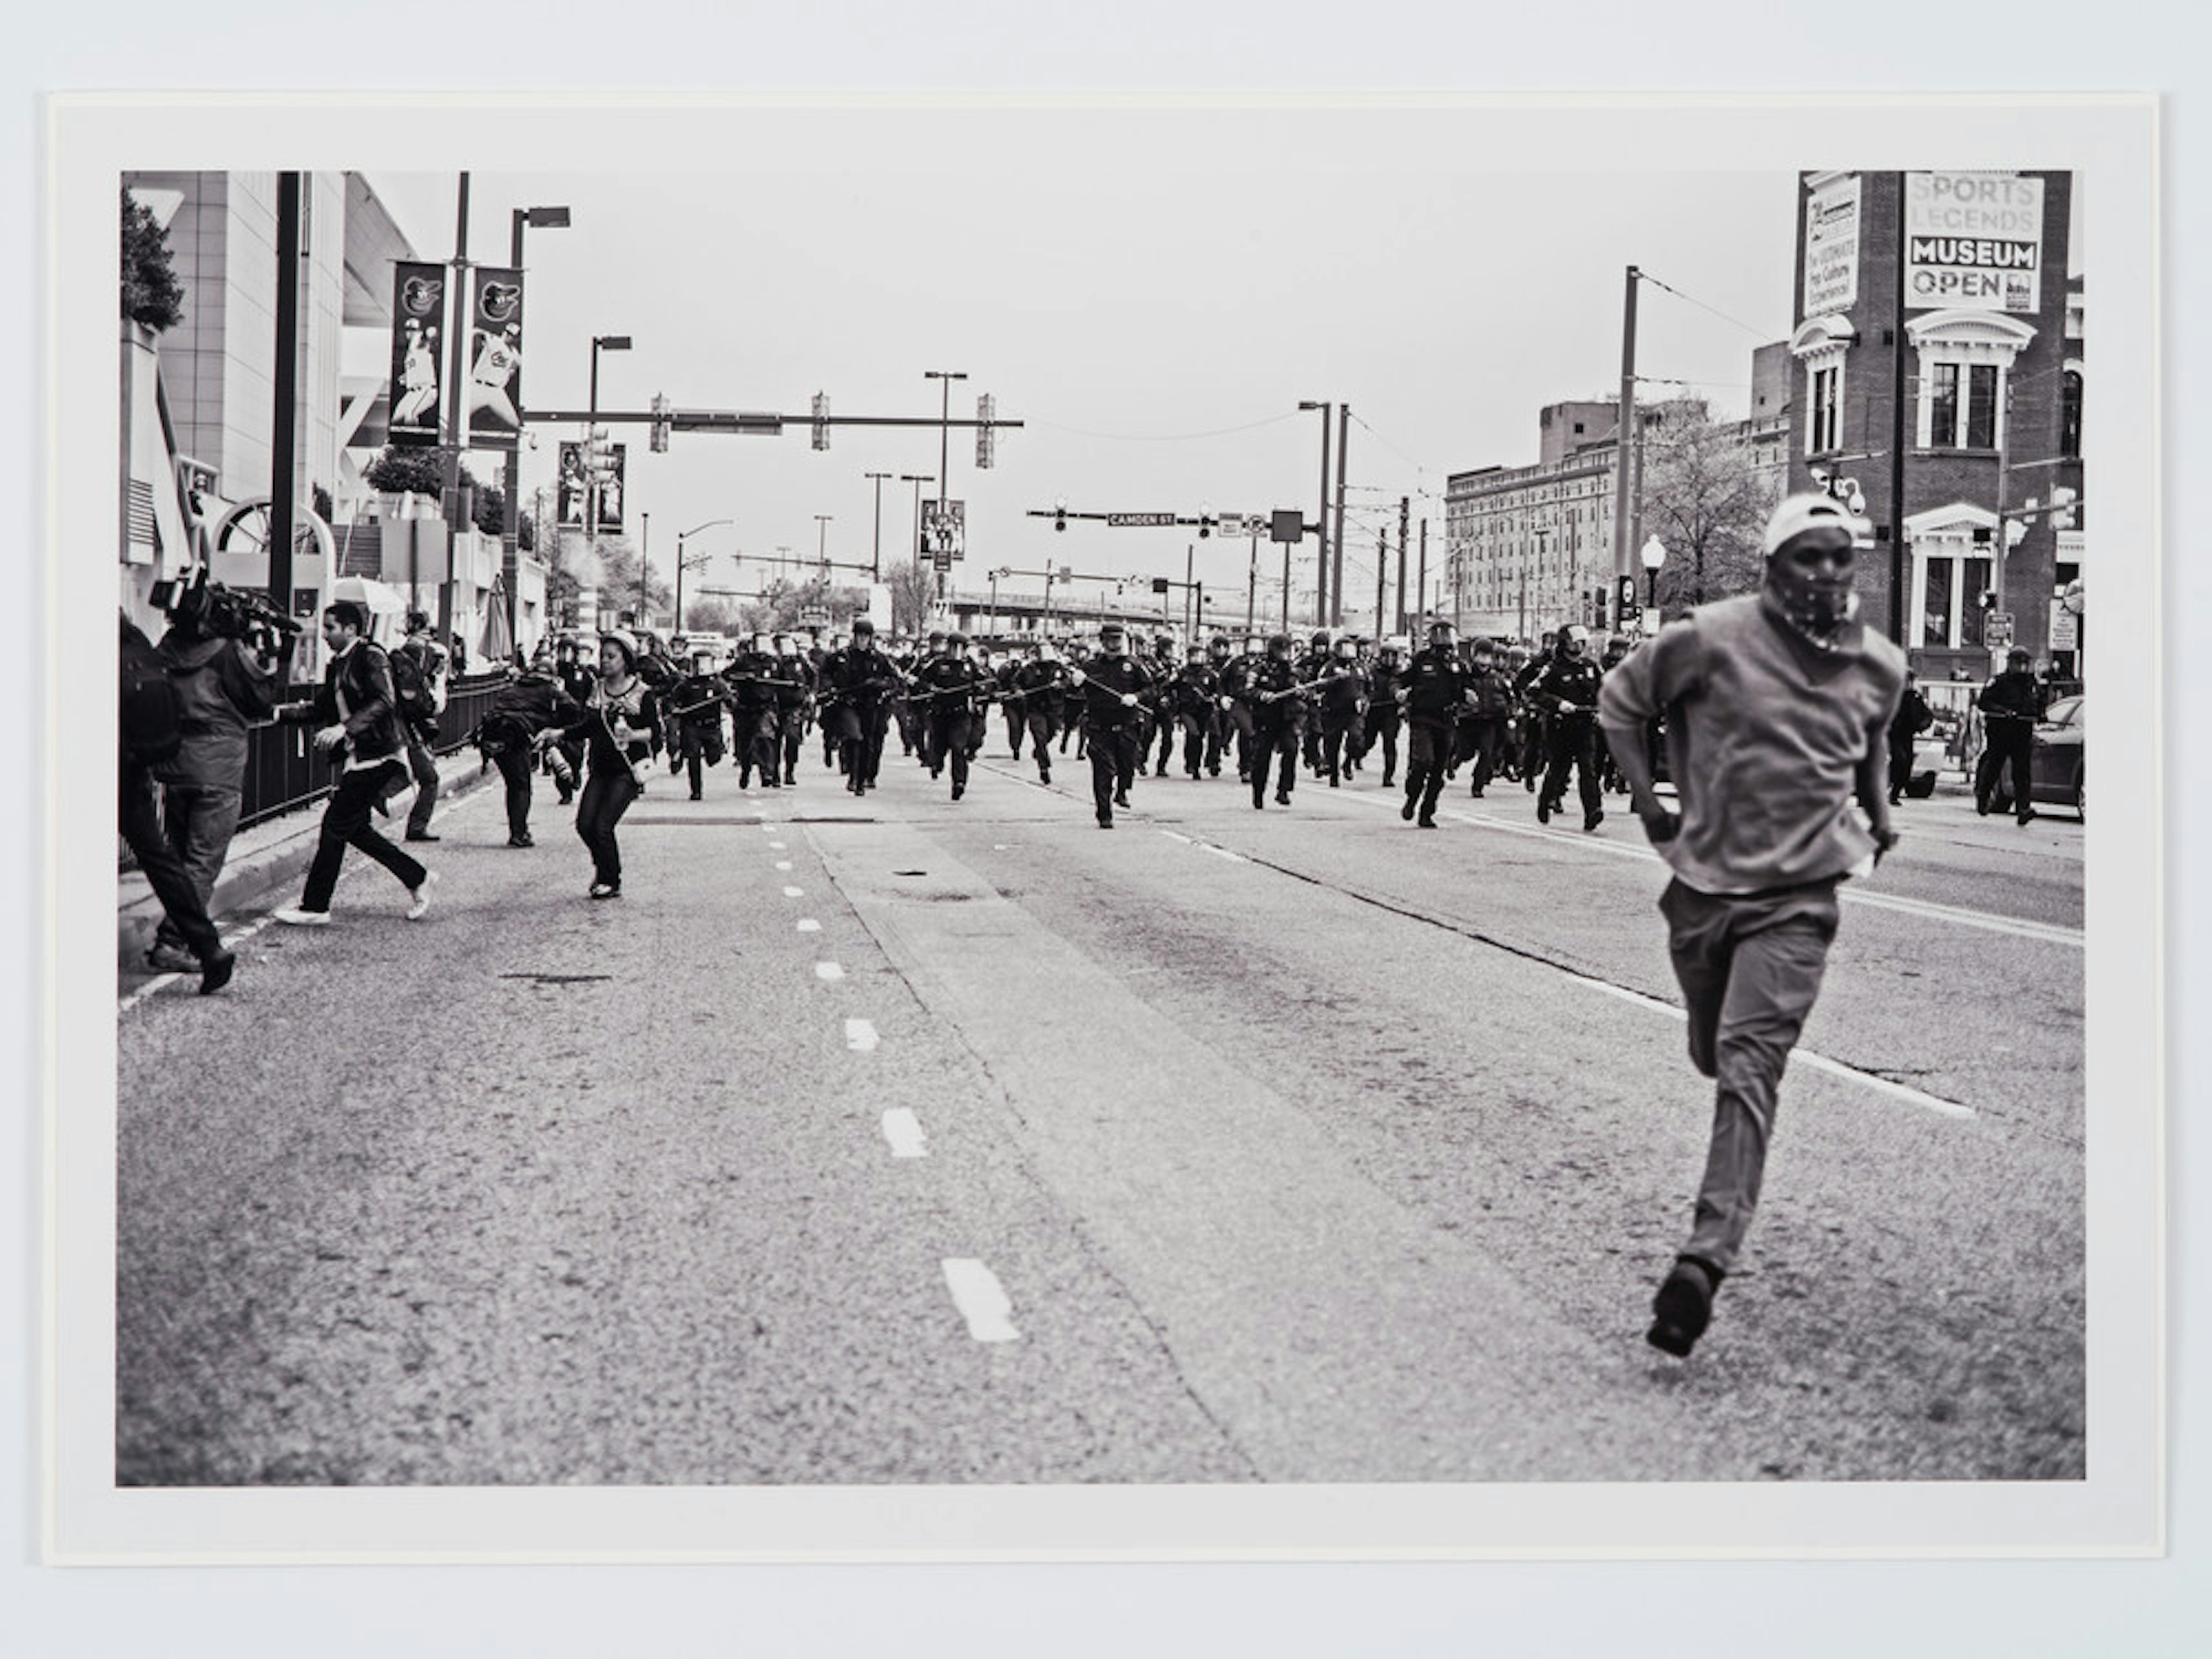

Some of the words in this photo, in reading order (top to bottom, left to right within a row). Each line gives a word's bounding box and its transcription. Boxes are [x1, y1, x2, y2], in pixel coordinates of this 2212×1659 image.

[1911, 176, 2036, 206] SPORTS
[1911, 207, 2034, 233] LEGENDS
[1912, 238, 2036, 269] MUSEUM
[1913, 270, 2000, 298] OPEN
[1109, 514, 1157, 525] CAMDEN
